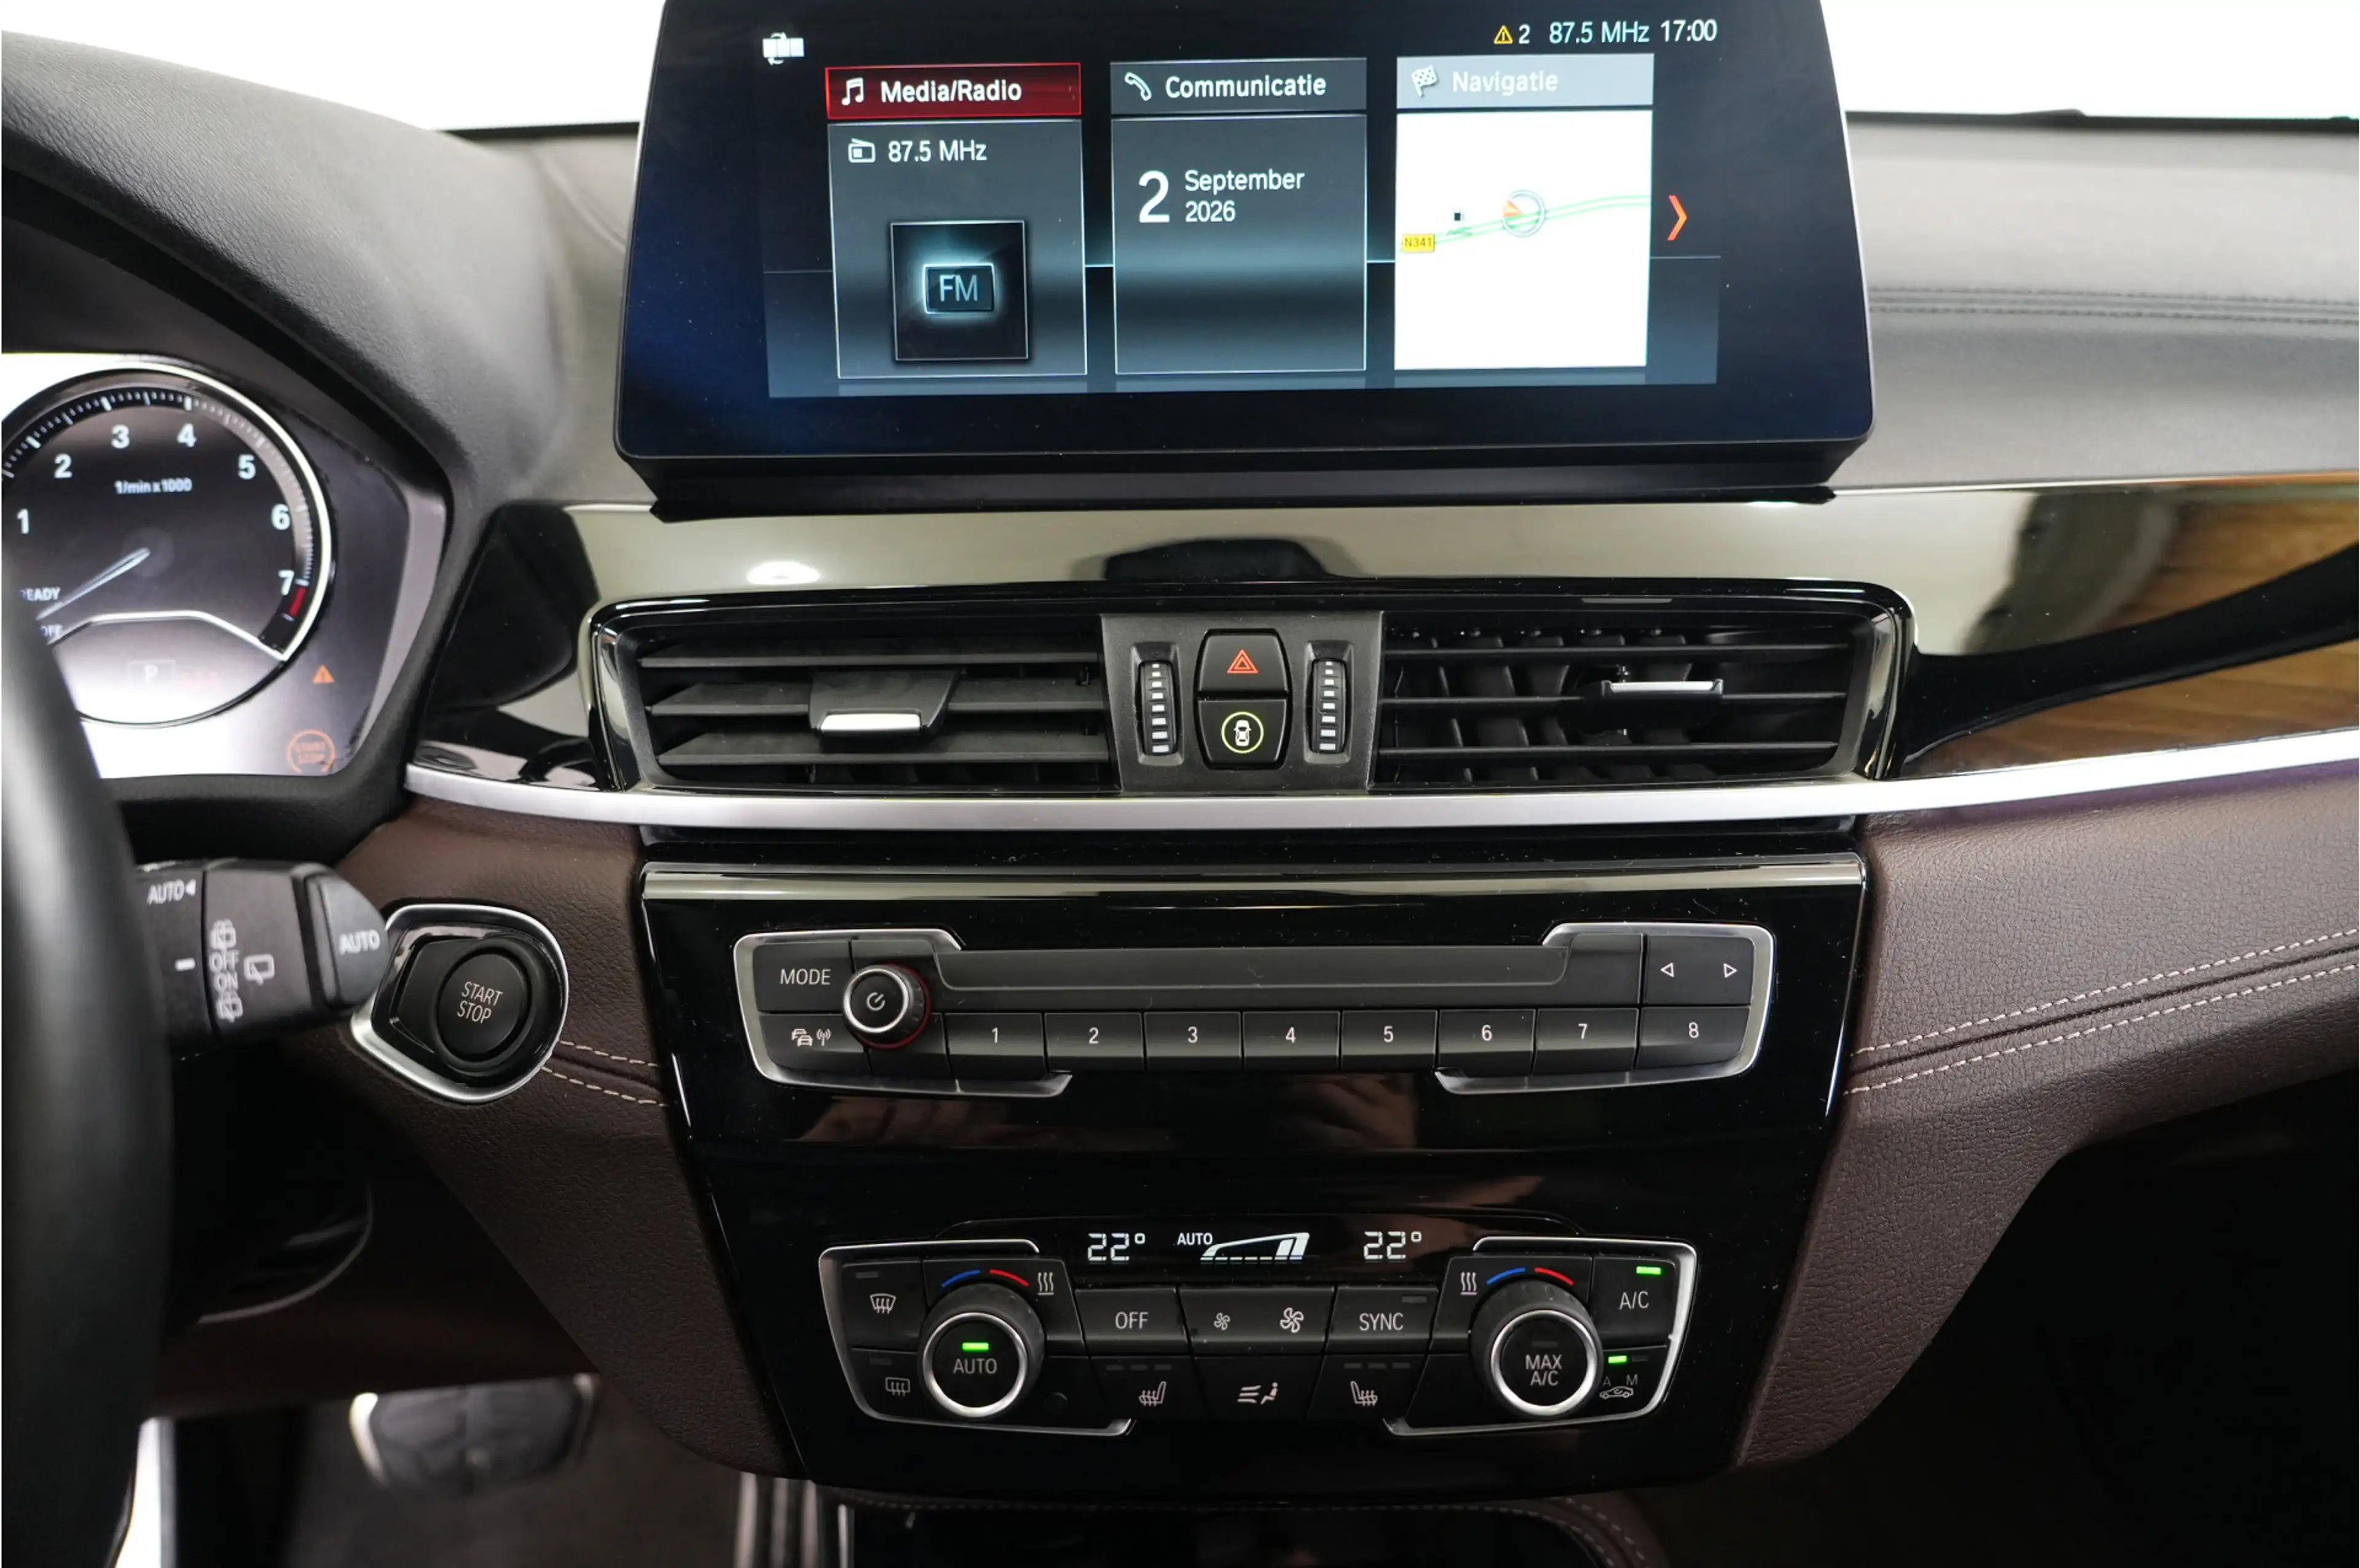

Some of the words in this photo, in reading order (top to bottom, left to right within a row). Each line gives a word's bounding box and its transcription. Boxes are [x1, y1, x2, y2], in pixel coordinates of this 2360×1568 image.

[1519, 25, 1530, 44] 2
[1549, 22, 1592, 44] 87.5
[1602, 21, 1650, 42] MHz
[1661, 19, 1717, 42] 17:00
[881, 79, 1021, 103] Media/Radio
[1166, 74, 1326, 98] Communicatie
[1453, 70, 1557, 96] Navigatie
[889, 140, 931, 162] 87.5
[940, 140, 987, 161] MHz
[1185, 169, 1305, 195] September
[1139, 171, 1170, 223] 2
[1186, 200, 1235, 222] 2026
[1404, 237, 1432, 248] N341
[940, 275, 977, 301] FM
[112, 425, 129, 448] 3
[178, 423, 196, 447] 4
[55, 454, 72, 478] 2
[238, 455, 256, 479] 5
[161, 477, 192, 492] 1000
[17, 509, 29, 533] 1
[272, 504, 289, 530] 6
[279, 570, 294, 595] 7
[148, 880, 184, 904] AUTO
[339, 930, 380, 954] AUTO
[210, 953, 239, 971] OFF
[214, 973, 239, 991] ON
[781, 969, 830, 985] MODE
[460, 982, 503, 1006] START
[457, 1000, 492, 1024] STOP
[993, 1027, 997, 1044] 1
[1089, 1027, 1098, 1044] 2
[1188, 1027, 1198, 1043] 3
[1286, 1027, 1296, 1043] 4
[1384, 1026, 1393, 1043] 5
[1482, 1025, 1492, 1041] 6
[1578, 1024, 1587, 1040] 7
[1689, 1022, 1699, 1038] 8
[1178, 1232, 1213, 1246] AUTO
[1620, 1291, 1649, 1309] A/C
[1115, 1312, 1148, 1329] OFF
[1359, 1312, 1403, 1331] SYNC
[953, 1358, 997, 1374] AUTO
[1526, 1354, 1562, 1370] MAX
[1530, 1370, 1559, 1386] A/C
[1627, 1374, 1637, 1386] M
